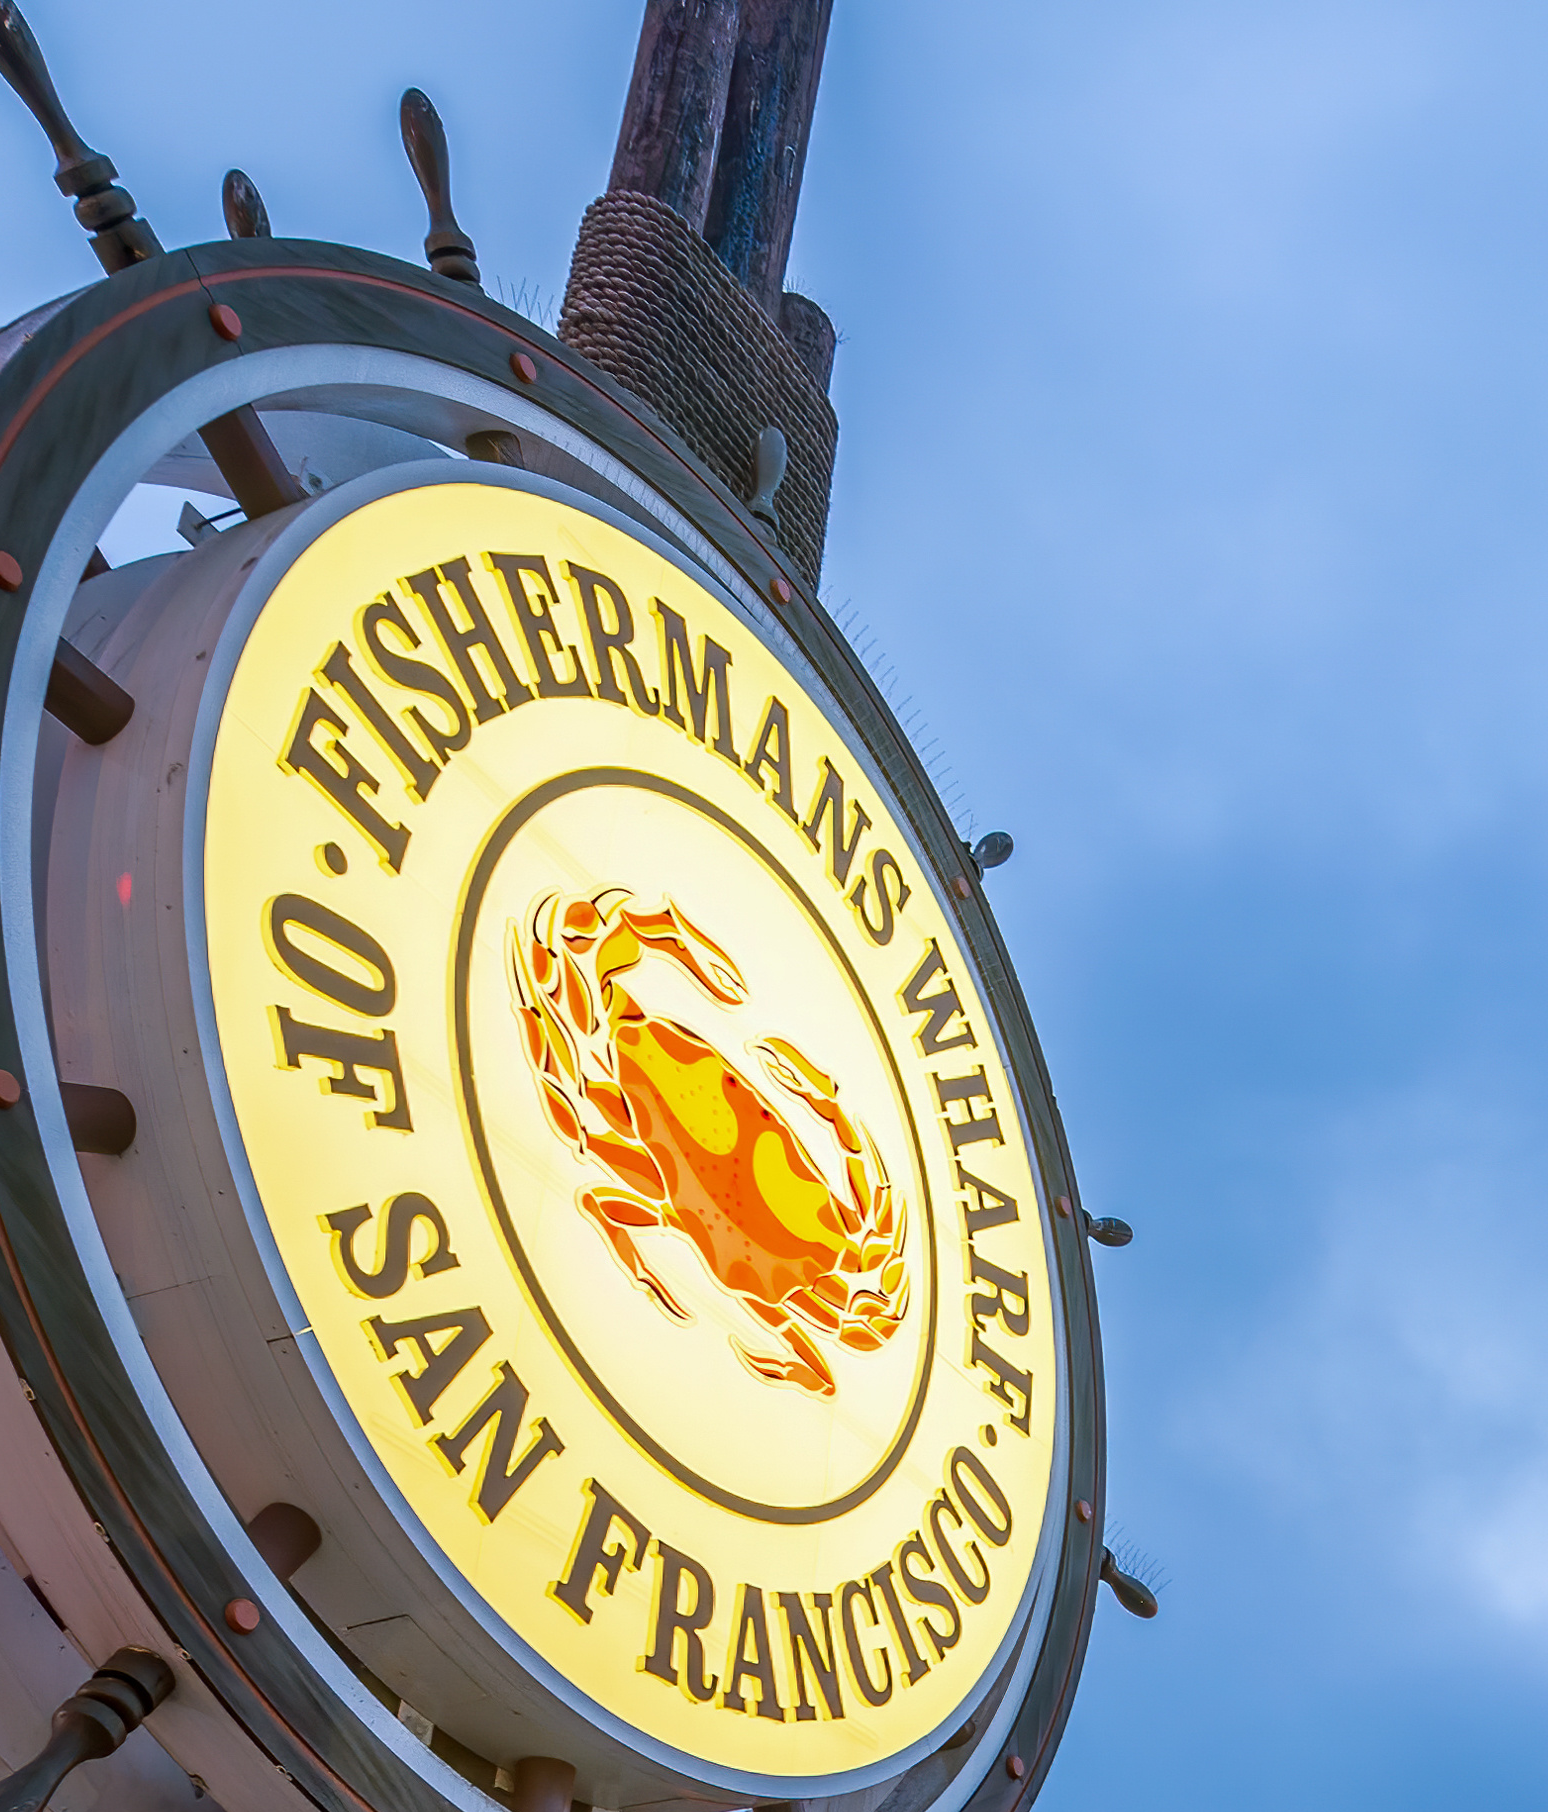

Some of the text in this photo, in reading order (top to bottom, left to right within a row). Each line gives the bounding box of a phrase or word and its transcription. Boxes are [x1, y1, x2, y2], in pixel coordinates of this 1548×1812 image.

[264, 889, 1013, 1722] OF SAN FRANCISCO
[283, 554, 1034, 1438] FISHERMANS WHARF
